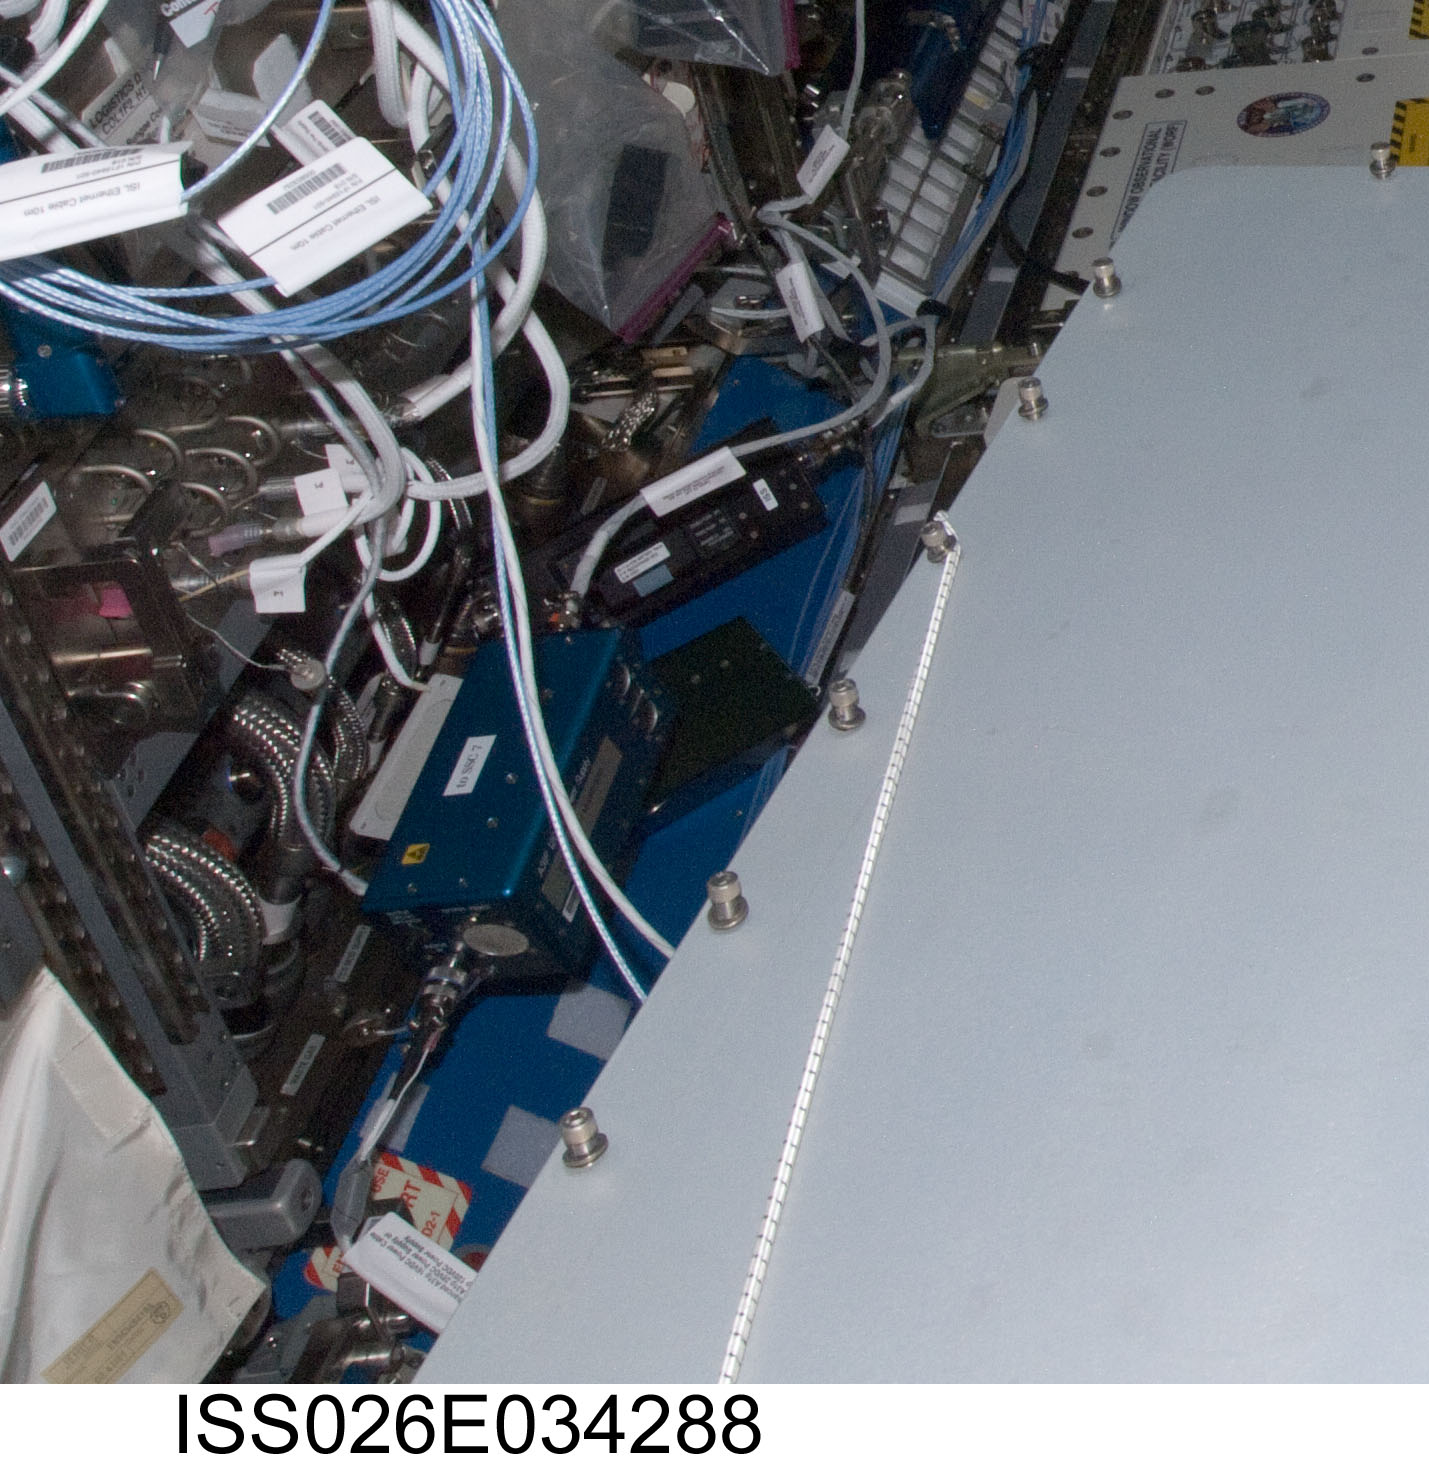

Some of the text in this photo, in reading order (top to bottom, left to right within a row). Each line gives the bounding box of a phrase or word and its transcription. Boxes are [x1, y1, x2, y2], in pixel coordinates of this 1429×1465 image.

[87, 78, 134, 129] LOGISTICS
[1160, 124, 1178, 149] (WORF)
[1129, 128, 1161, 193] OBSERVATIONAL
[47, 197, 78, 212] Cable
[78, 186, 122, 204] Ethernet
[22, 205, 46, 218] 10m
[331, 202, 367, 228] Ethernet
[308, 222, 334, 241] Cable
[462, 754, 478, 773] SSC
[386, 1243, 406, 1262] Power
[412, 1252, 430, 1269] Power
